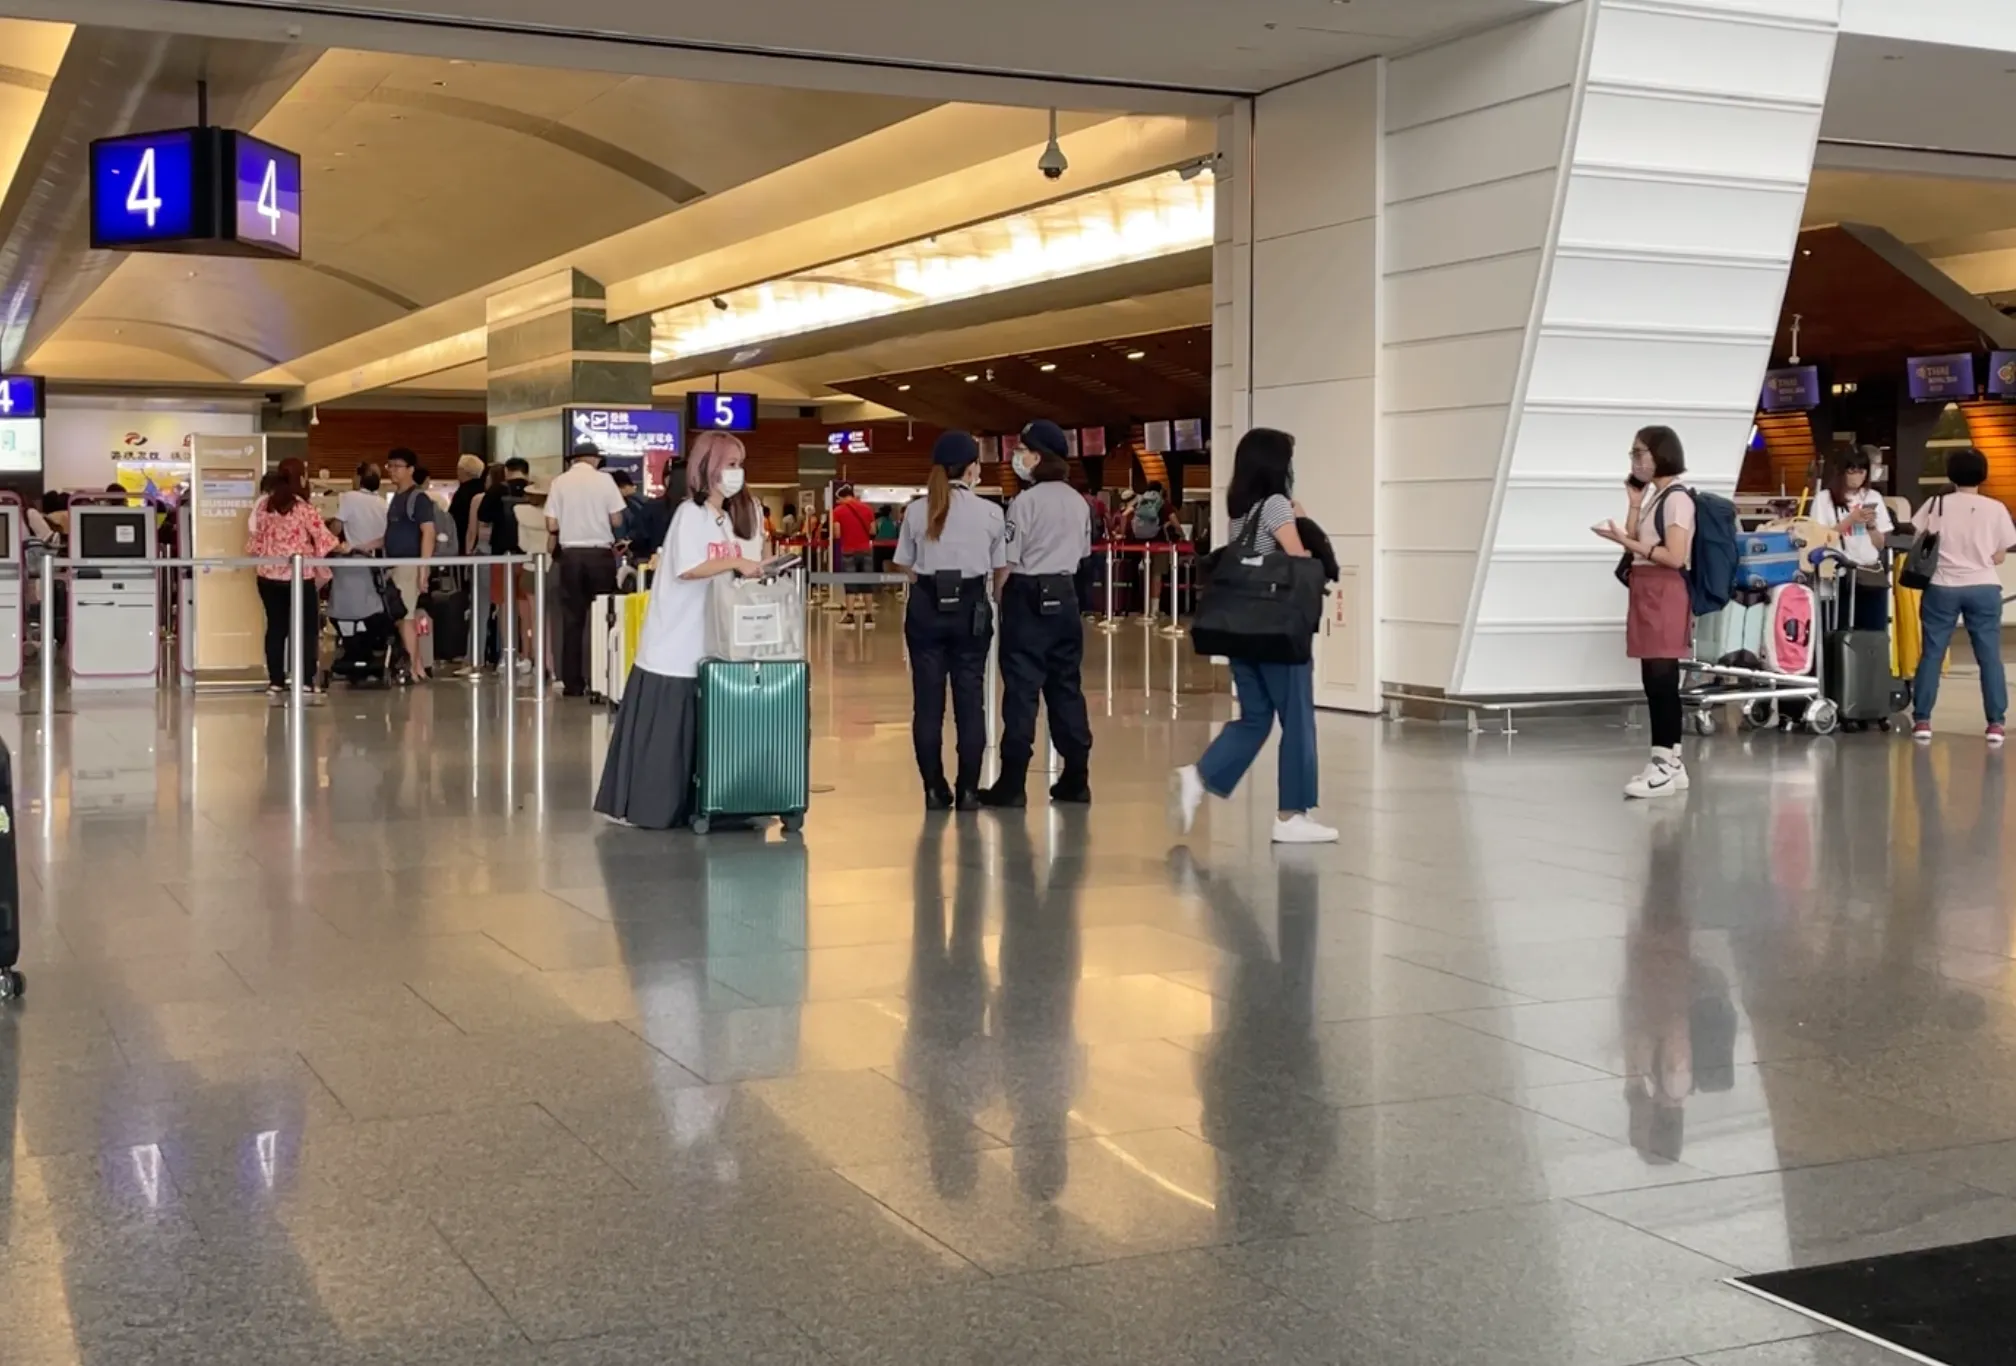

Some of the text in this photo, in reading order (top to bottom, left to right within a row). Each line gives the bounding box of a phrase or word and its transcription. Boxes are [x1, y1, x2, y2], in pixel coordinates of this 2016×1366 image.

[126, 147, 162, 228] 4
[257, 158, 281, 236] 4
[0, 379, 14, 413] 4
[714, 396, 734, 427] 5
[200, 509, 237, 518] CLASS
